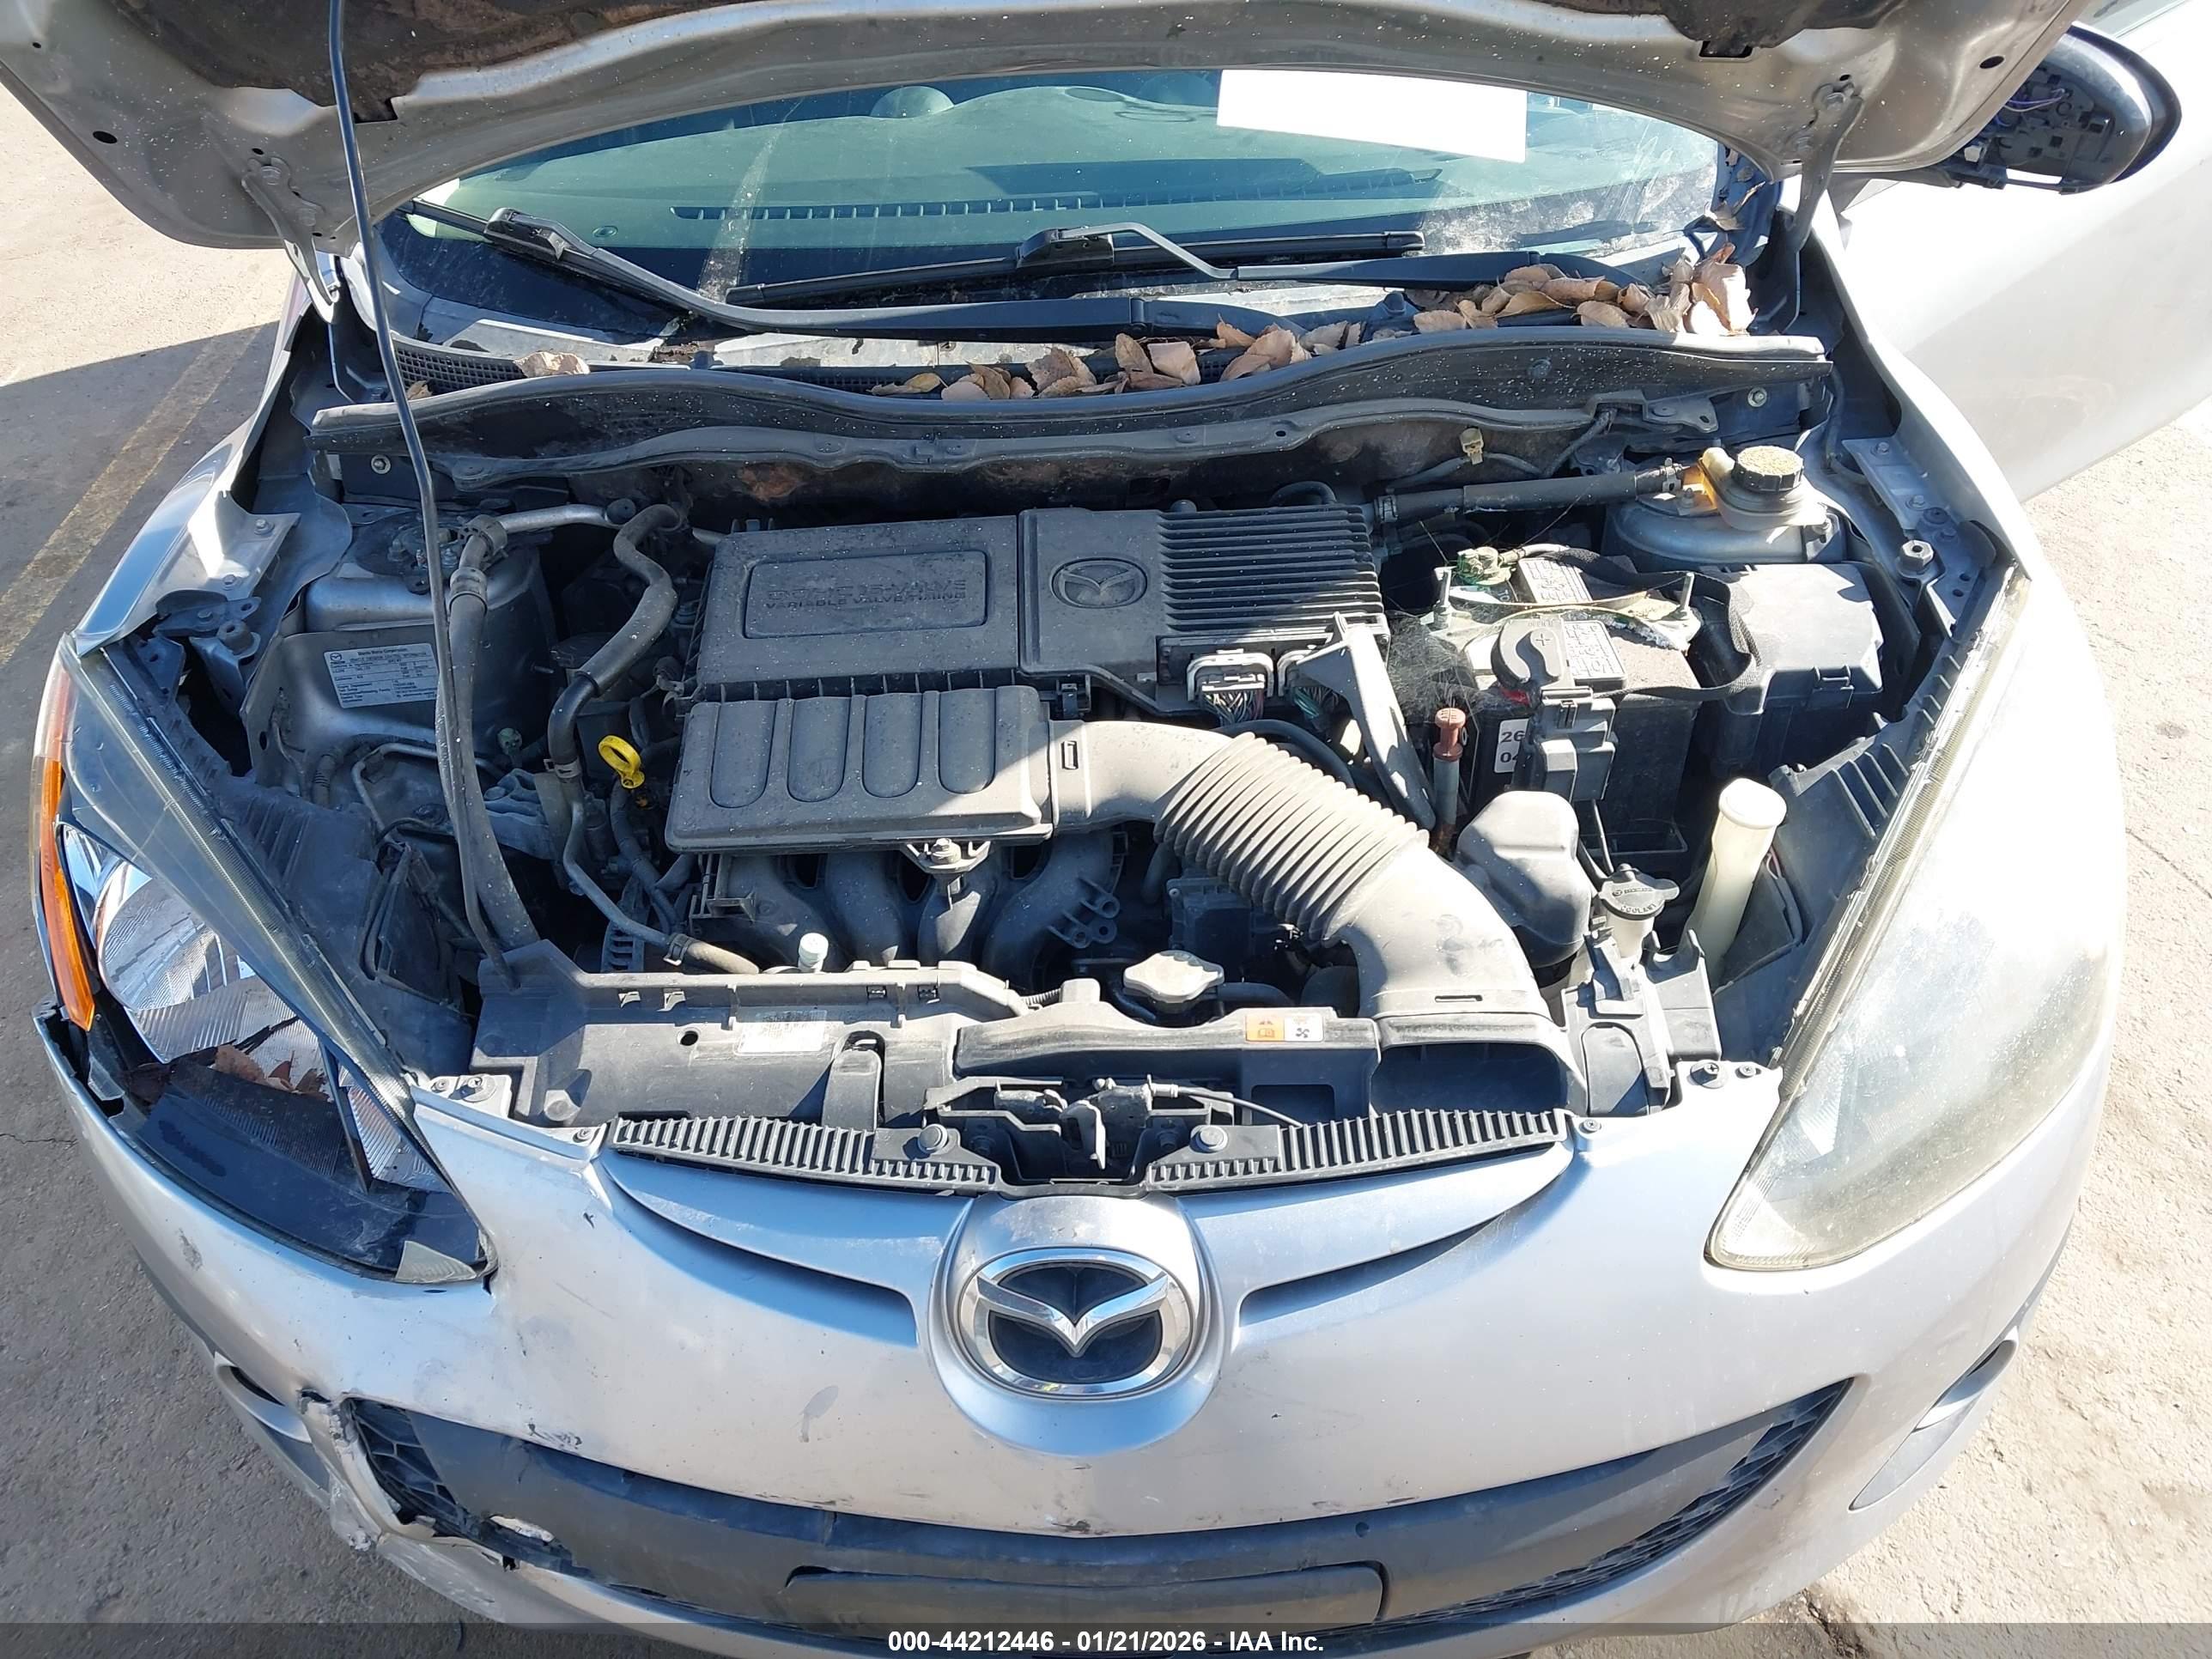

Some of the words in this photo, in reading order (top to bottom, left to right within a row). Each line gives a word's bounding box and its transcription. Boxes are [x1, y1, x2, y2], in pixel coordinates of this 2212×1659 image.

[766, 598, 848, 609] VARIABLE
[853, 595, 902, 605] VALVE
[1620, 902, 1657, 914] COOLANT
